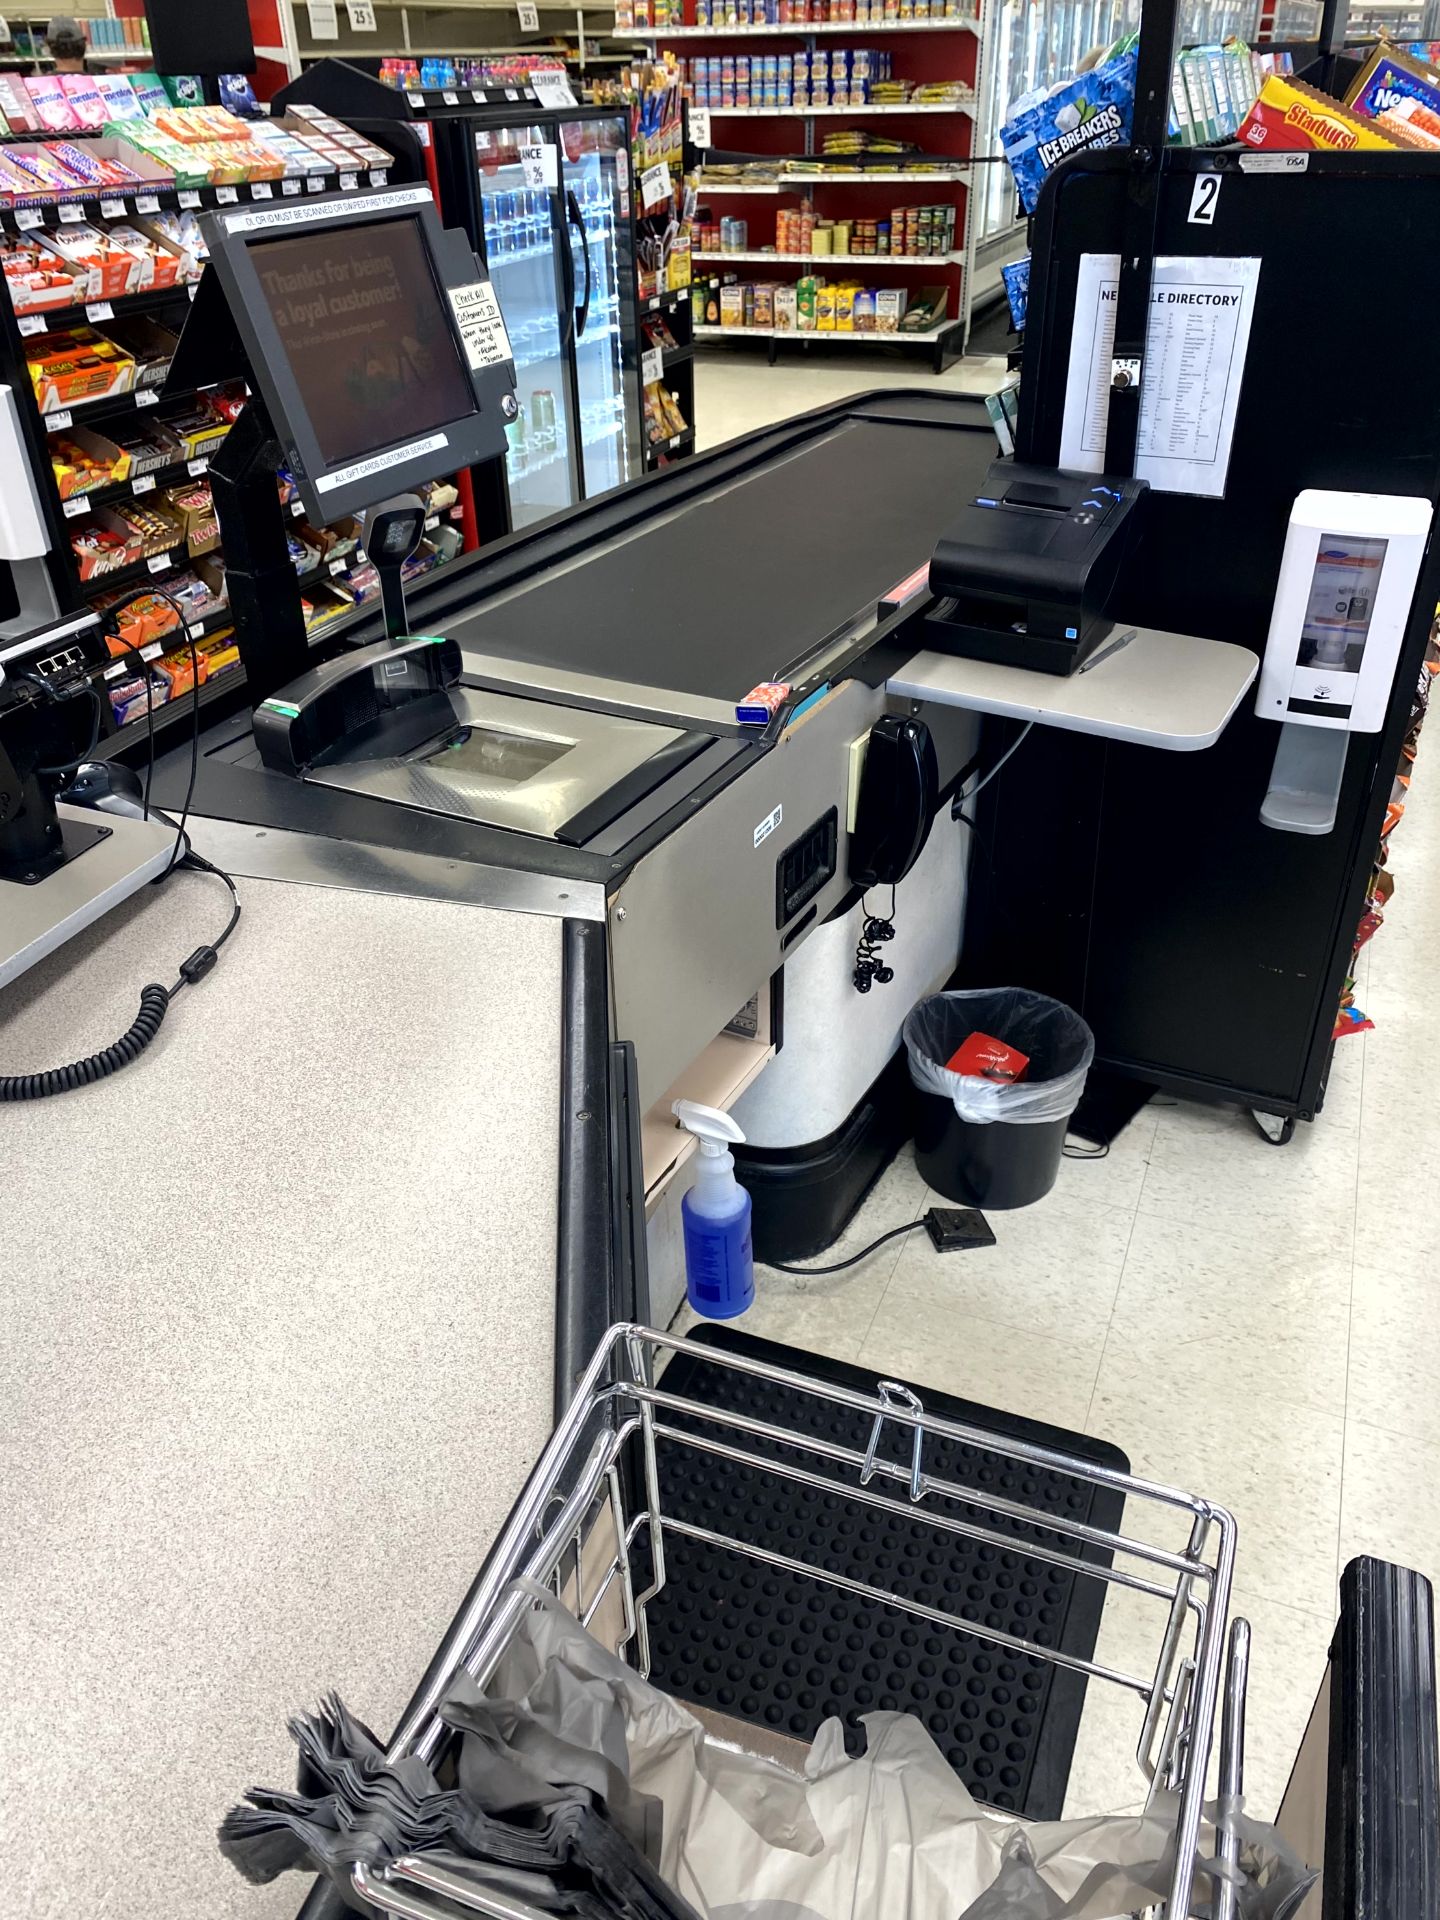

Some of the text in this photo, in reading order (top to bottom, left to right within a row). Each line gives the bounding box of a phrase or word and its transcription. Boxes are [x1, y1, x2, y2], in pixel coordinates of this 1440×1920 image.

[354, 10, 365, 24] 25
[31, 92, 63, 106] mentos
[68, 91, 99, 105] mentos
[103, 88, 133, 101] mentos
[138, 88, 165, 101] mentos
[1251, 125, 1266, 138] 36
[1287, 104, 1357, 150] Starburst
[1037, 105, 1121, 169] ICE BREAKERS
[60, 192, 96, 203] mentos
[101, 189, 136, 199] mentos
[1194, 177, 1218, 219] 2
[16, 195, 54, 208] mentos
[255, 214, 267, 224] OR
[275, 210, 292, 222] MUST
[293, 209, 303, 219] BE
[302, 205, 333, 218] SCANNED
[333, 203, 342, 213] OR
[343, 200, 365, 211] SWIPED
[366, 197, 380, 208] FIRST
[382, 196, 395, 205] FOR
[394, 192, 417, 203] CHECKS
[63, 232, 94, 245] bueno
[262, 253, 397, 295] Thanks for being
[455, 290, 475, 305] Check
[1167, 293, 1239, 306] DIRECTORY
[276, 308, 289, 327] a
[287, 293, 329, 328] loyal
[486, 304, 495, 316] ID
[136, 454, 171, 475] HERSHEY'S
[335, 440, 433, 483] ALL GIFT CARDS CUSTOMER SERVICE
